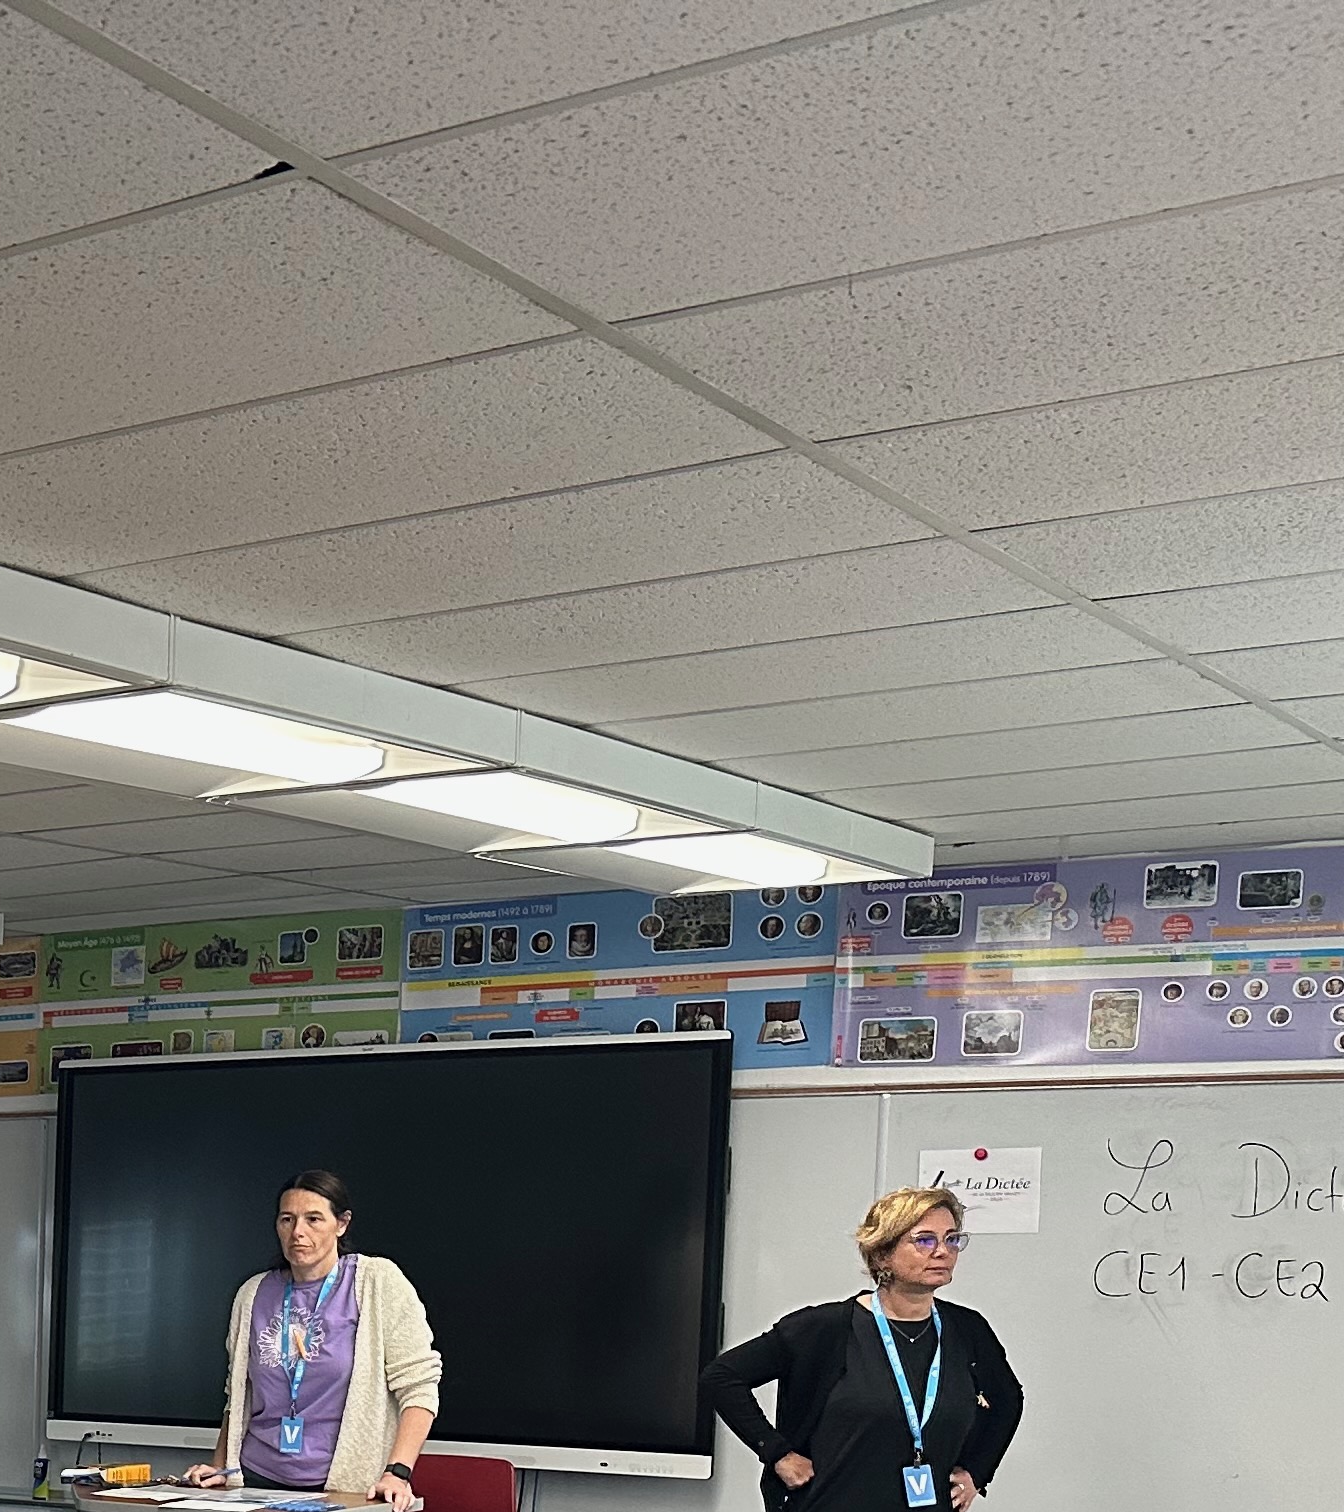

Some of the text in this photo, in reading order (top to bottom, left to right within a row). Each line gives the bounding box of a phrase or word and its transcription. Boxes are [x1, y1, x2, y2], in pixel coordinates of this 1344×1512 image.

[908, 876, 988, 889] contemporaine
[1023, 871, 1051, 882] 1789)
[424, 913, 451, 923] Temps
[452, 910, 497, 921] modernes
[498, 906, 520, 918] (1492
[57, 940, 82, 949] Moyen
[965, 1176, 1031, 1190] La Dictée
[1103, 1137, 1173, 1216] La
[283, 1424, 301, 1444] V
[906, 1473, 928, 1496] V
